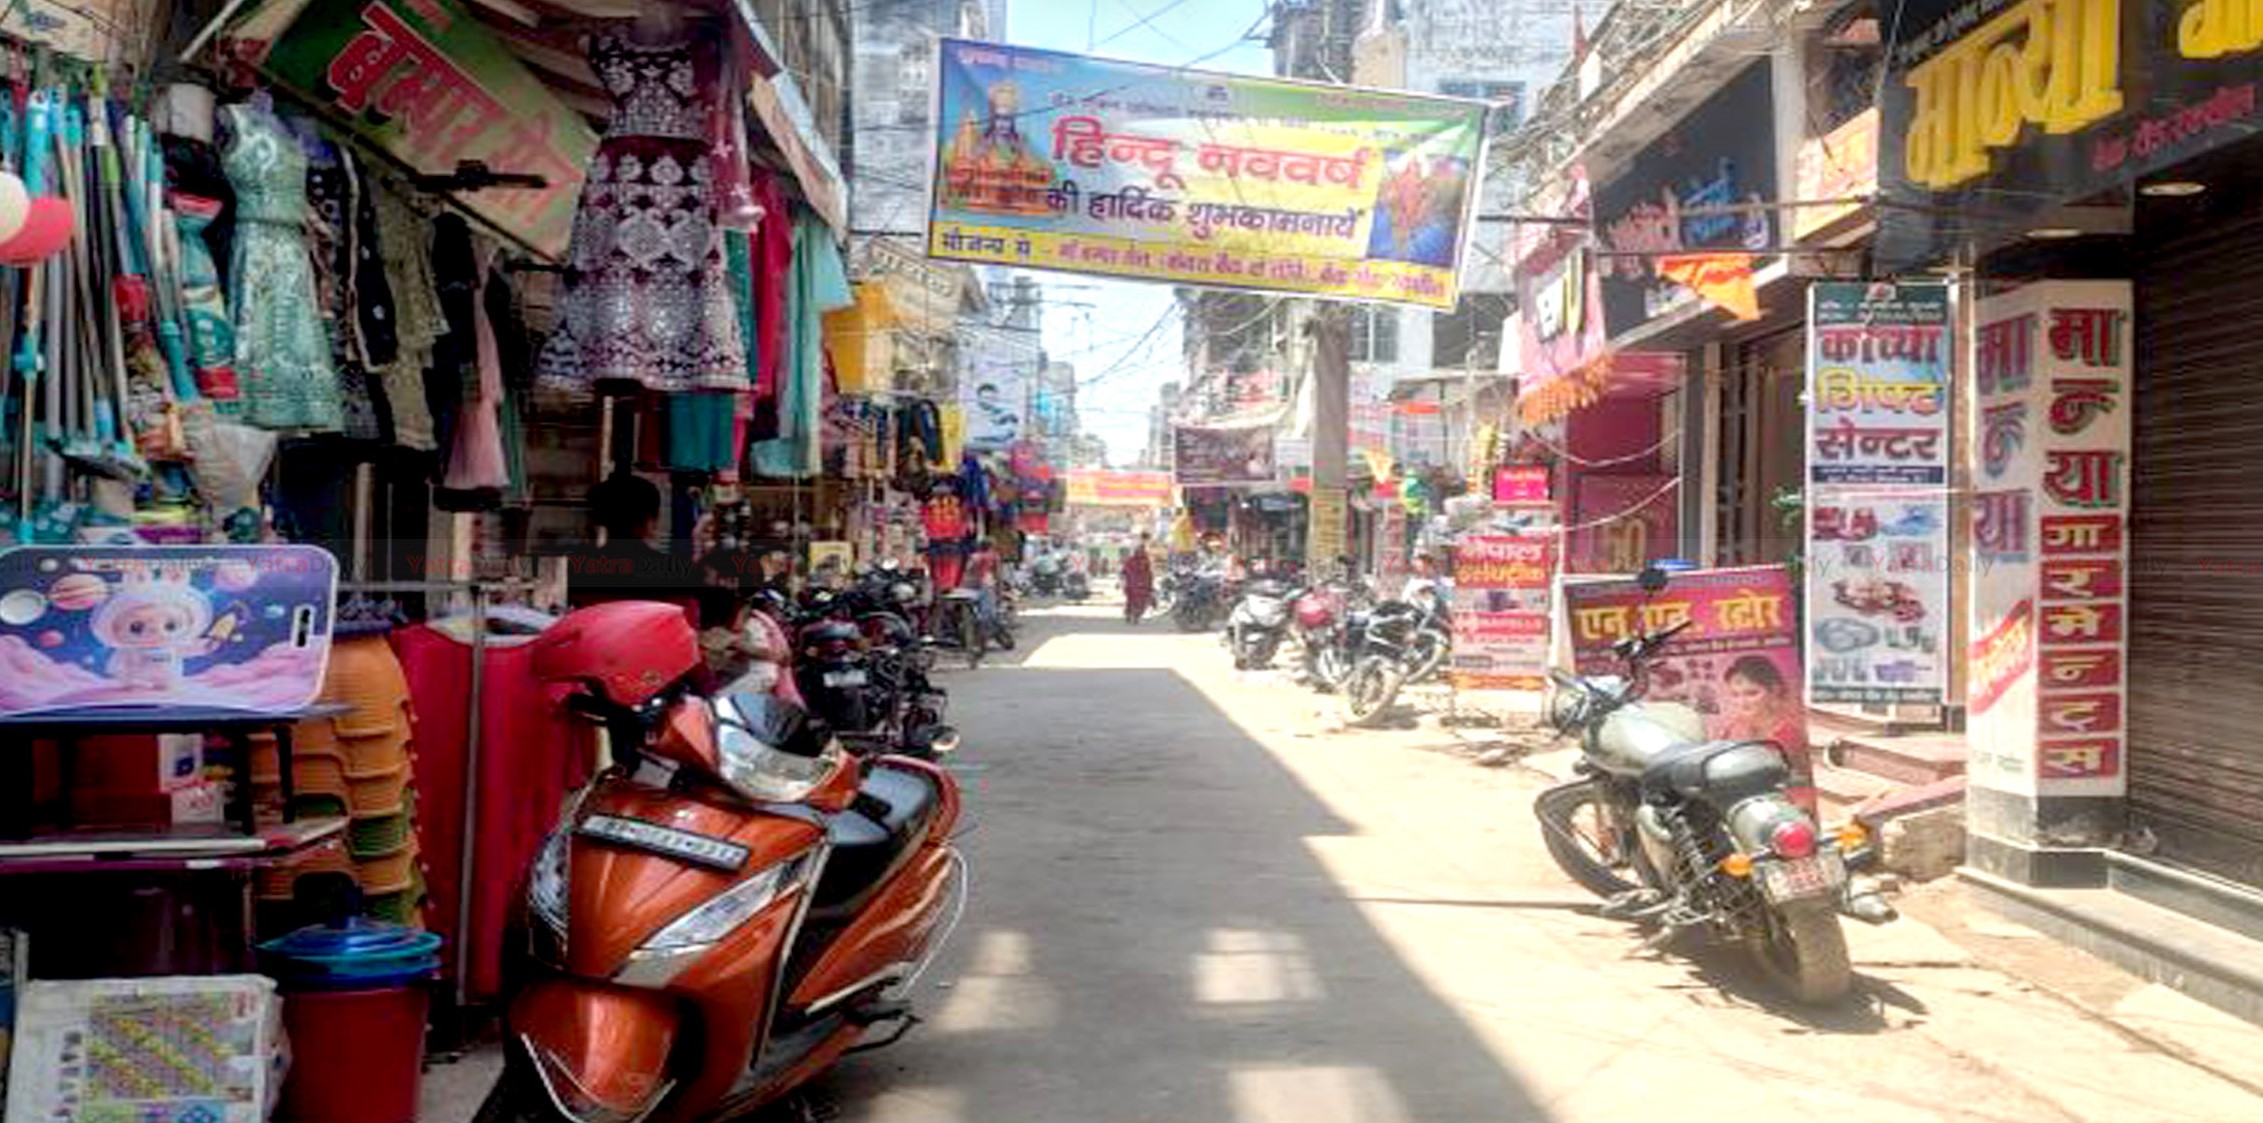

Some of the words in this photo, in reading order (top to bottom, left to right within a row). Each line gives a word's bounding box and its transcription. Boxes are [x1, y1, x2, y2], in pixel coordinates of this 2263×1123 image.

[1053, 115, 1182, 188] हिन्दू
[1197, 143, 1370, 191] नववर्ष
[1046, 181, 1080, 218] की
[1088, 185, 1176, 225] हार्दिक
[1822, 324, 1943, 363] काव्या
[1815, 415, 1943, 460] सेन्टर
